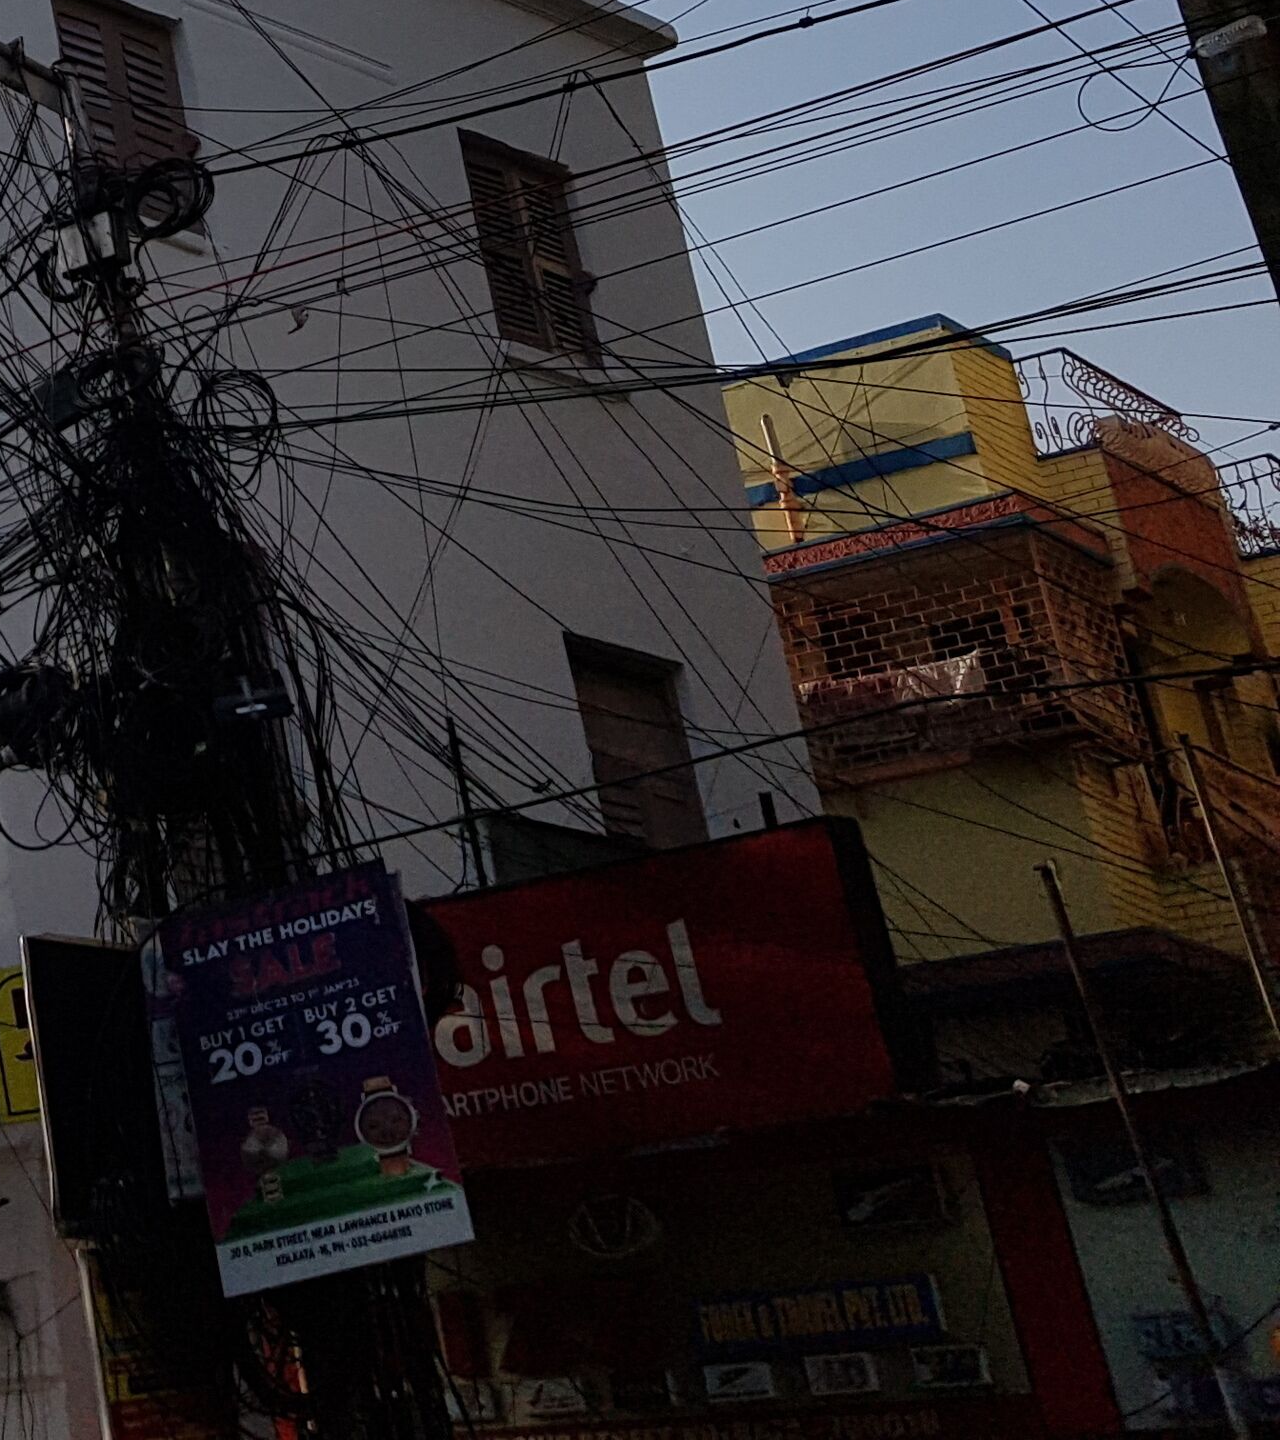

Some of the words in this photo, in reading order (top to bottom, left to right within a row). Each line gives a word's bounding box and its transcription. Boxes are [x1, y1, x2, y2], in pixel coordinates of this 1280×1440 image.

[182, 940, 229, 967] SLAY
[235, 925, 274, 952] THE
[280, 899, 376, 942] HOLIDAYS
[230, 932, 341, 993] SALE
[304, 1004, 340, 1024] BUY
[344, 998, 357, 1014] 2
[362, 985, 399, 1008] GET
[434, 918, 722, 1067] airtel
[200, 1031, 236, 1051] BUY
[250, 1015, 285, 1036] GET
[316, 1012, 372, 1056] 30
[208, 1041, 263, 1085] 20
[580, 1054, 721, 1098] NETWORK
